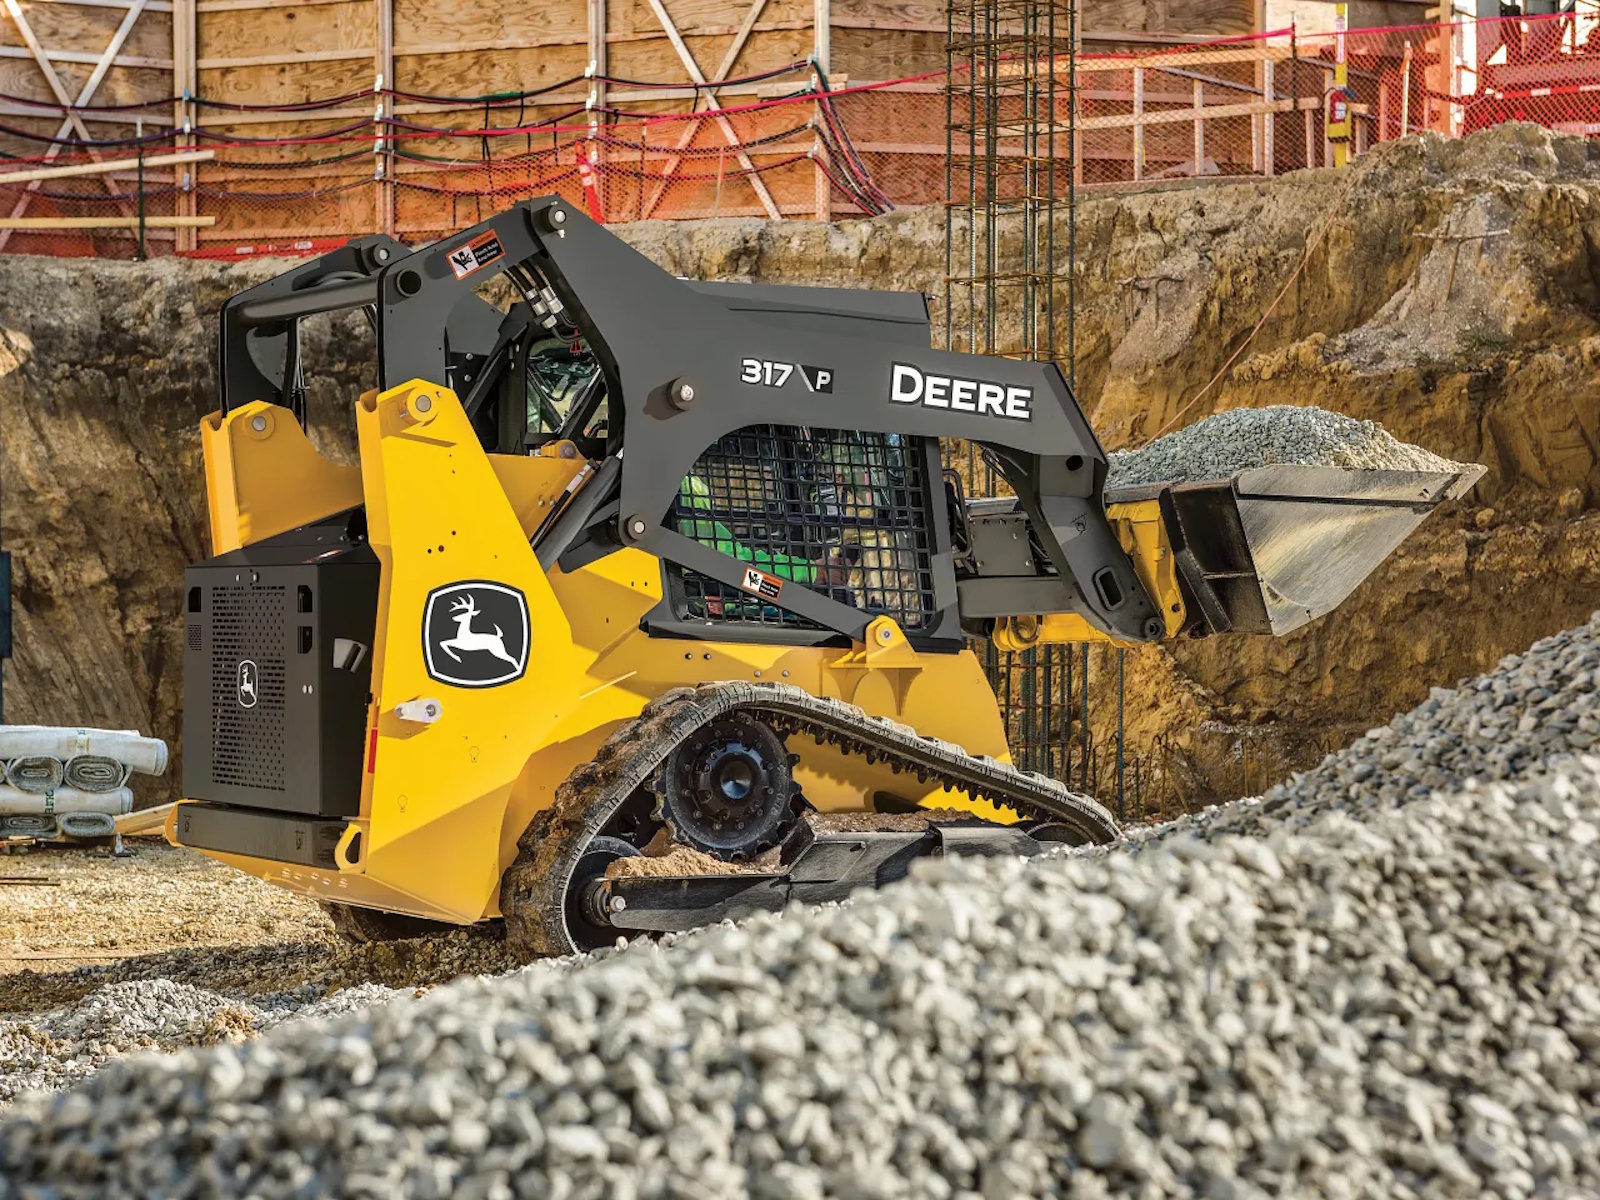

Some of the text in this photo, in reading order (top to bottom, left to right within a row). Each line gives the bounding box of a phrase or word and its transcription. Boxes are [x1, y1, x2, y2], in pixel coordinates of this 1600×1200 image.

[741, 359, 831, 390] 317 P
[891, 364, 1031, 418] DEERE
